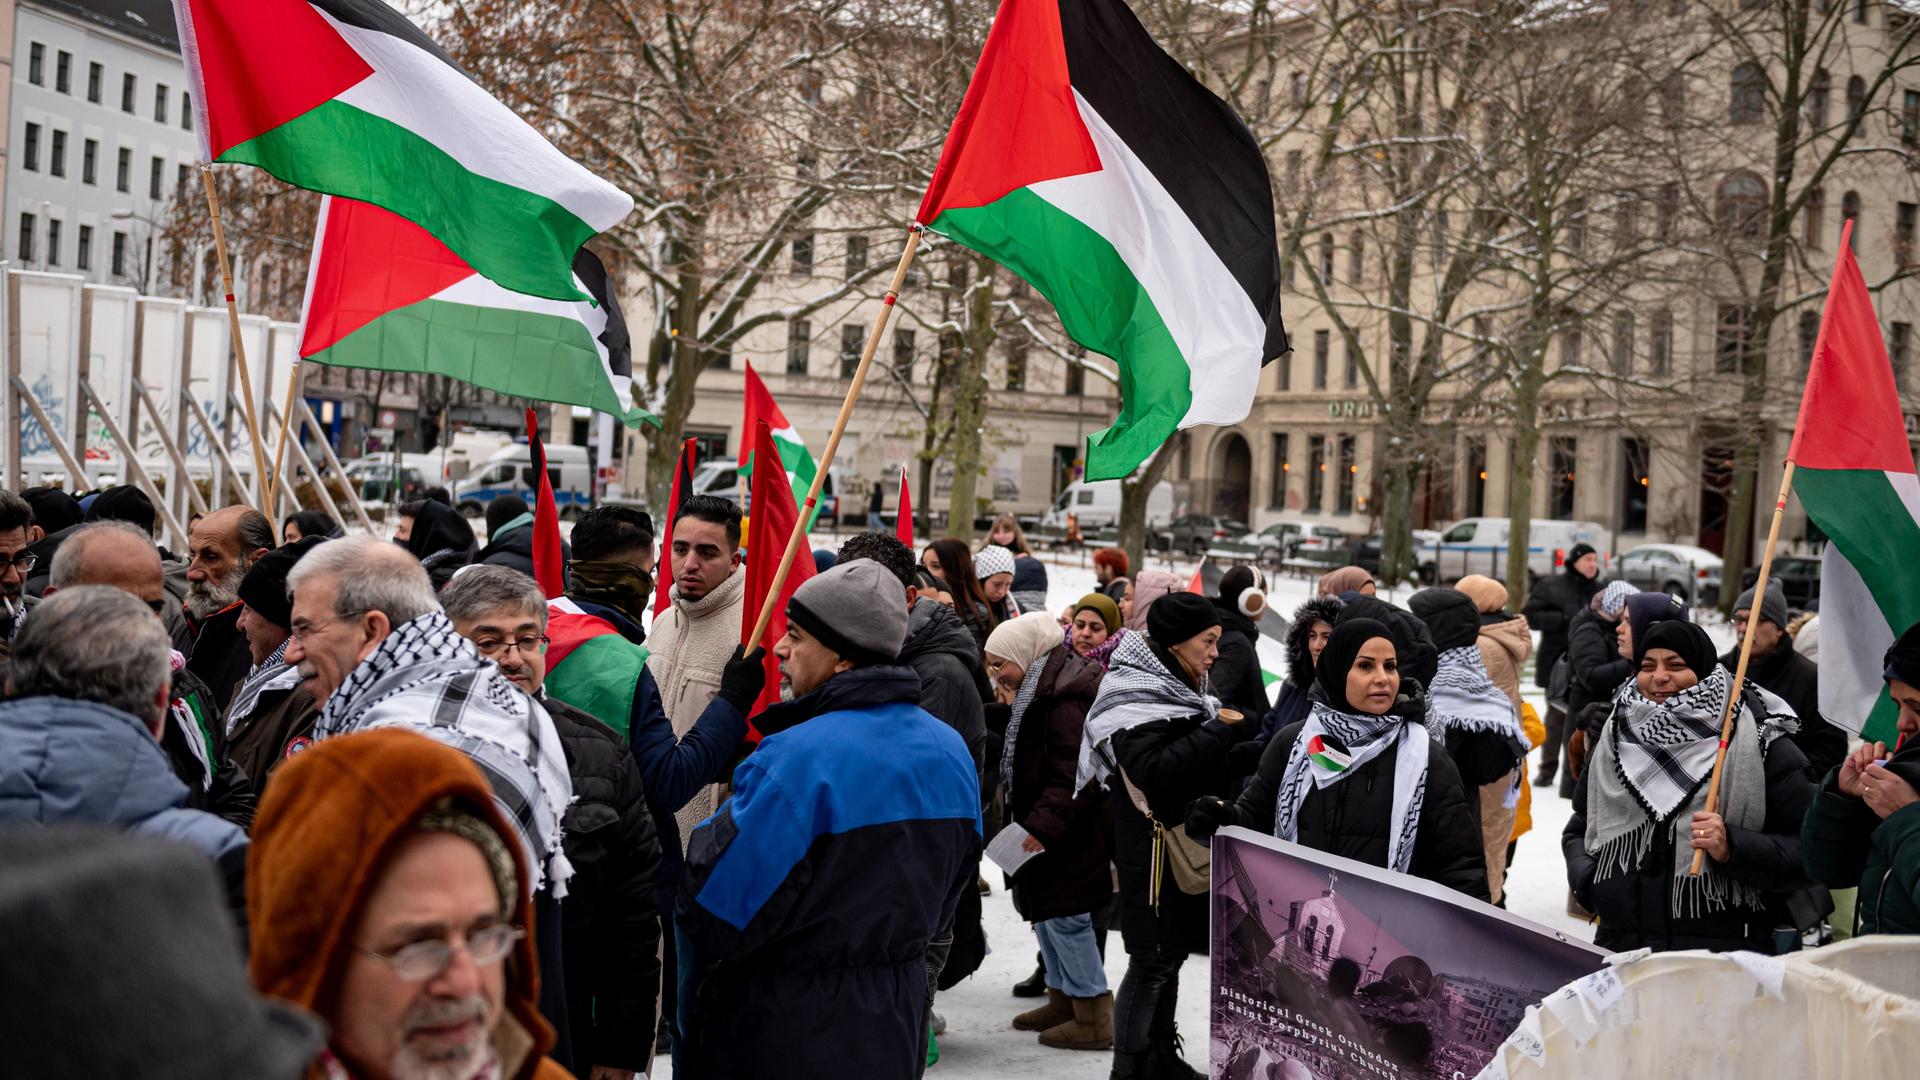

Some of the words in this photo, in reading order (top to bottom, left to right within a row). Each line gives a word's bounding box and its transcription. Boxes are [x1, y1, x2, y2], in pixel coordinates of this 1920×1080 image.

[1220, 986, 1290, 1018] historical
[1295, 1013, 1333, 1038] Greek
[1338, 1034, 1399, 1072] Orthodox
[1228, 1001, 1264, 1021] Saint
[1270, 1016, 1344, 1056] Porphyrius
[1350, 1052, 1396, 1080] Church
